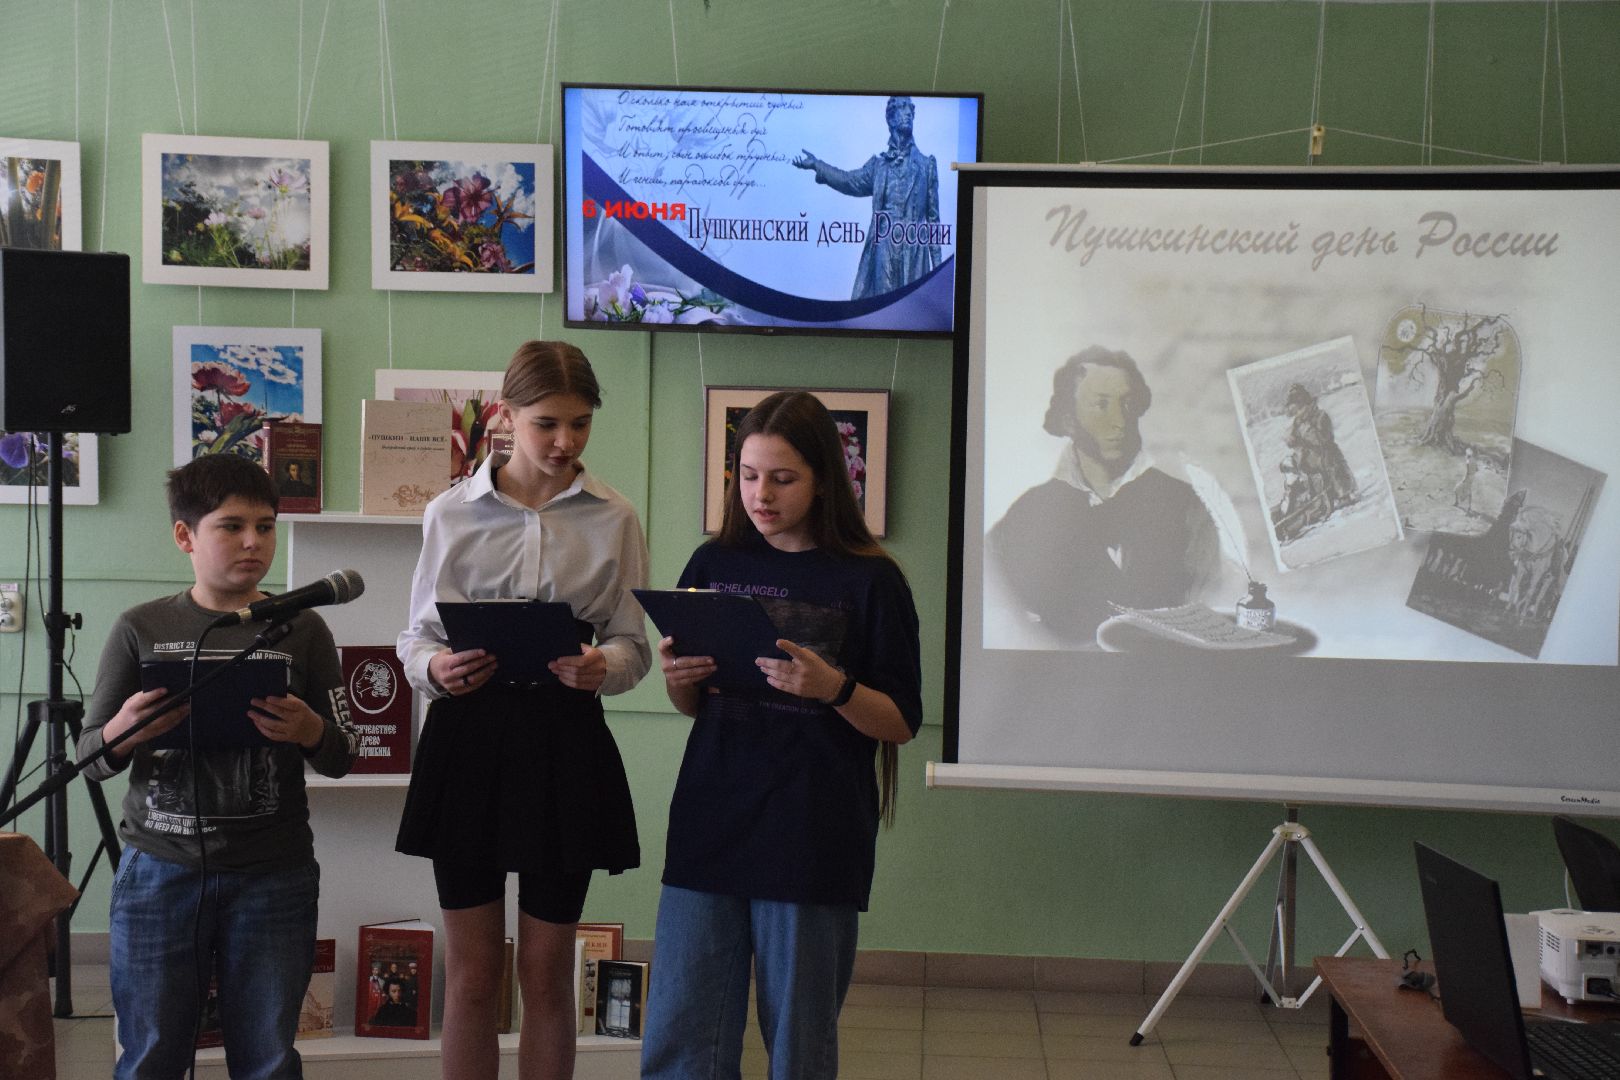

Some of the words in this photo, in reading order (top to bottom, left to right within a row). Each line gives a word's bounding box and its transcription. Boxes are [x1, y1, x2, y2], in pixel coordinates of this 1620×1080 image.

[582, 199, 597, 219] 6
[688, 205, 808, 251] Пушкинский
[816, 220, 865, 247] день
[874, 210, 953, 246] России
[1045, 203, 1301, 267] Пушкинский
[1310, 225, 1400, 272] день
[1415, 209, 1560, 259] России
[153, 642, 185, 650] DISTRICT
[244, 652, 263, 660] EAM
